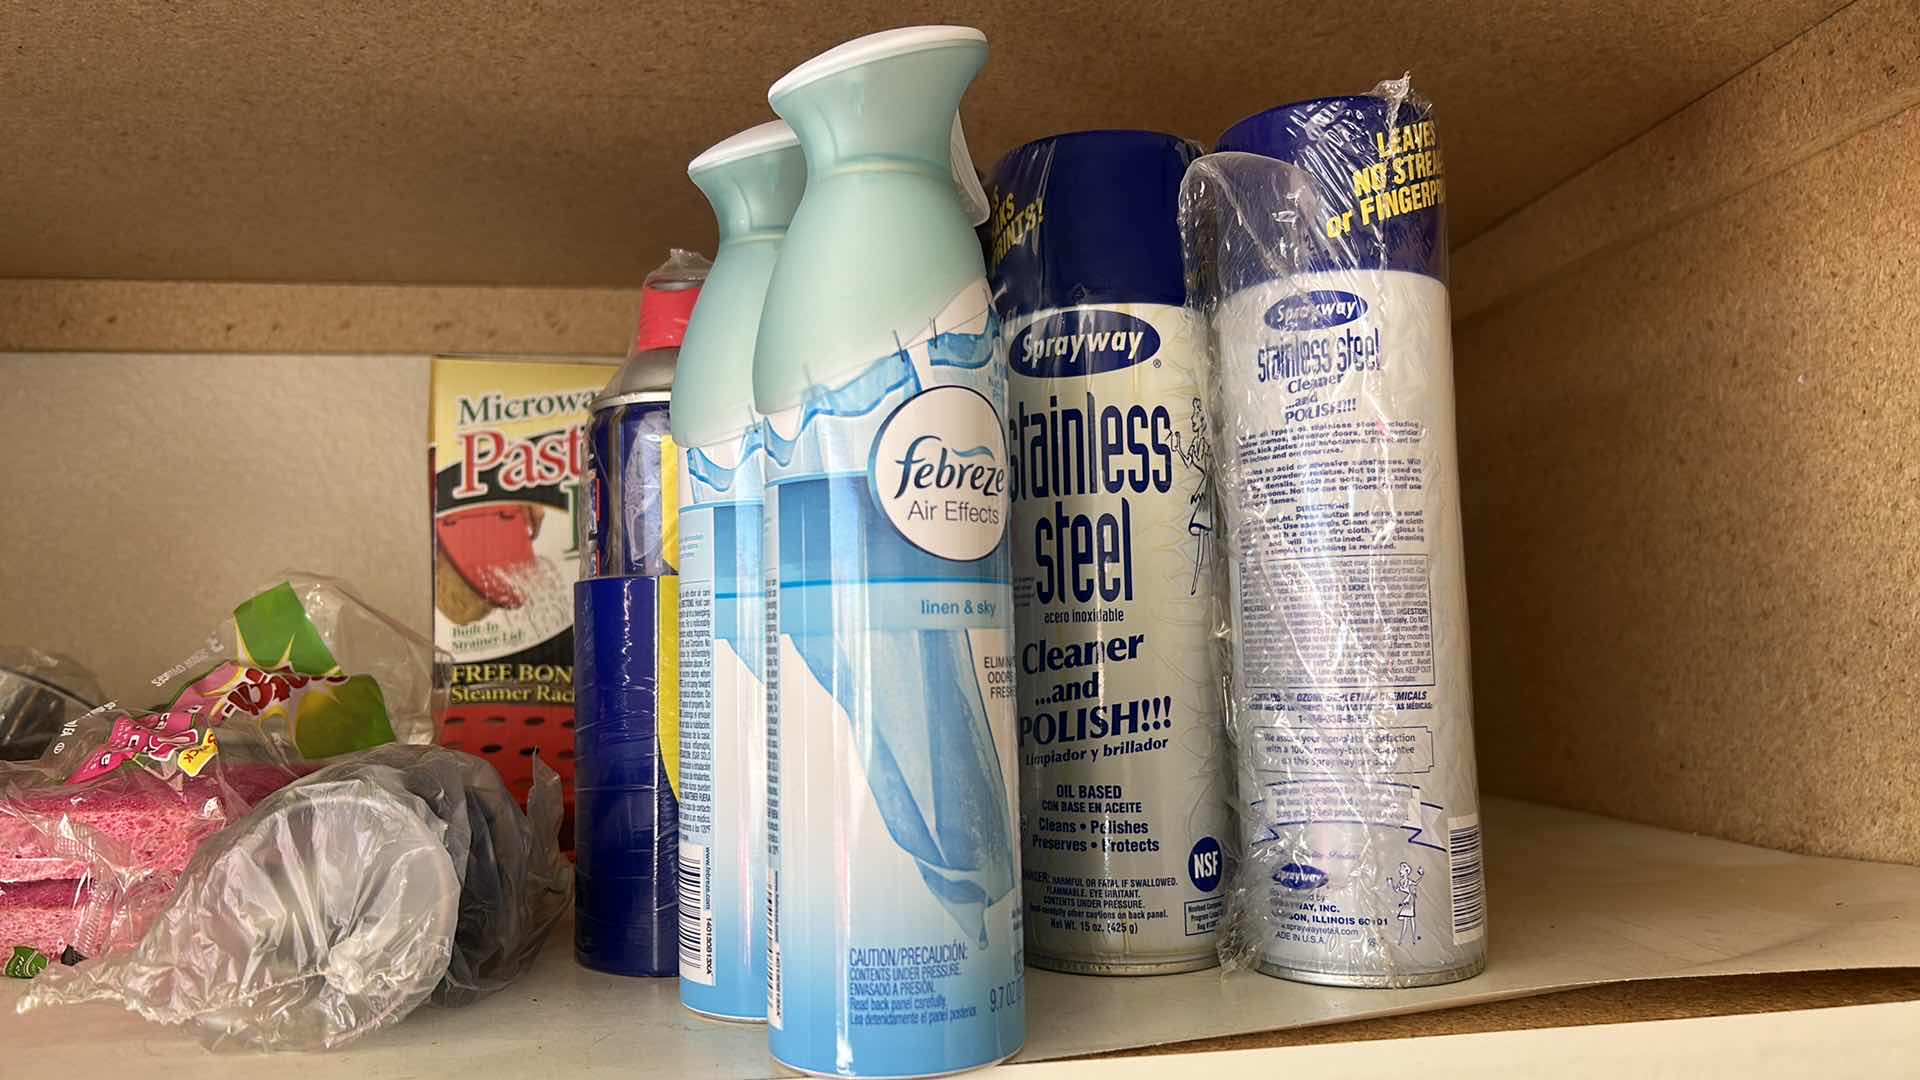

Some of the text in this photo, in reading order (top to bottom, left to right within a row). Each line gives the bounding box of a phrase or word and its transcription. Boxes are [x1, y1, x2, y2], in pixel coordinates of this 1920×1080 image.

[1353, 150, 1445, 196] NO STREA
[1327, 209, 1353, 239] or
[1277, 300, 1358, 323] Sprayway
[1021, 331, 1144, 368] Sprayway
[1258, 328, 1381, 383] stainless steel
[1287, 372, 1344, 394] Cleaner
[459, 391, 600, 425] Microwa
[453, 425, 584, 498] Past
[894, 435, 1005, 499] febreze
[907, 500, 999, 525] Air Effects
[1035, 497, 1133, 604] steel
[921, 599, 996, 617] linen & sky
[1044, 608, 1124, 624] acero inoxidable
[1022, 634, 1144, 675] Cleaner
[452, 664, 573, 683] FREE BON
[452, 686, 533, 704] Steamer
[1035, 672, 1099, 706] ...and
[1019, 696, 1171, 747] POLISH!!!
[1026, 737, 1169, 767] Limpiador y brillador
[1056, 785, 1122, 799] OIL BASED
[1042, 800, 1142, 813] CON BASE EN ACEITE
[1039, 817, 1149, 834] Cleans Polishes
[1032, 835, 1159, 853] Preserves Protects
[1194, 851, 1218, 879] NSF
[1086, 879, 1096, 888] OR
[1098, 879, 1118, 888] FATAL
[1121, 879, 1129, 888] IF
[1131, 878, 1178, 888] SWALLOWED.
[1089, 889, 1103, 898] EYE
[1077, 899, 1101, 909] UNDER
[1103, 899, 1145, 909] PRESSURE.
[1320, 905, 1340, 913] INC.
[1117, 911, 1127, 919] on
[1128, 910, 1145, 919] back
[1147, 909, 1168, 920] panel.
[1312, 915, 1355, 926] ILLINOIS
[1080, 922, 1090, 932] 15
[1093, 924, 1104, 933] oz.
[1107, 922, 1127, 934] (425
[1130, 922, 1138, 934] g)
[1275, 931, 1327, 944] ADE IN U.S.A.
[850, 967, 891, 981] CONTENTS
[893, 965, 920, 981] UNDER
[850, 981, 892, 996] ENVASADO
[893, 981, 898, 995] A
[850, 997, 869, 1011] Read
[871, 997, 888, 1011] back
[891, 997, 912, 1012] panel
[990, 985, 1004, 1013] 9.7
[929, 1009, 948, 1025] panel
